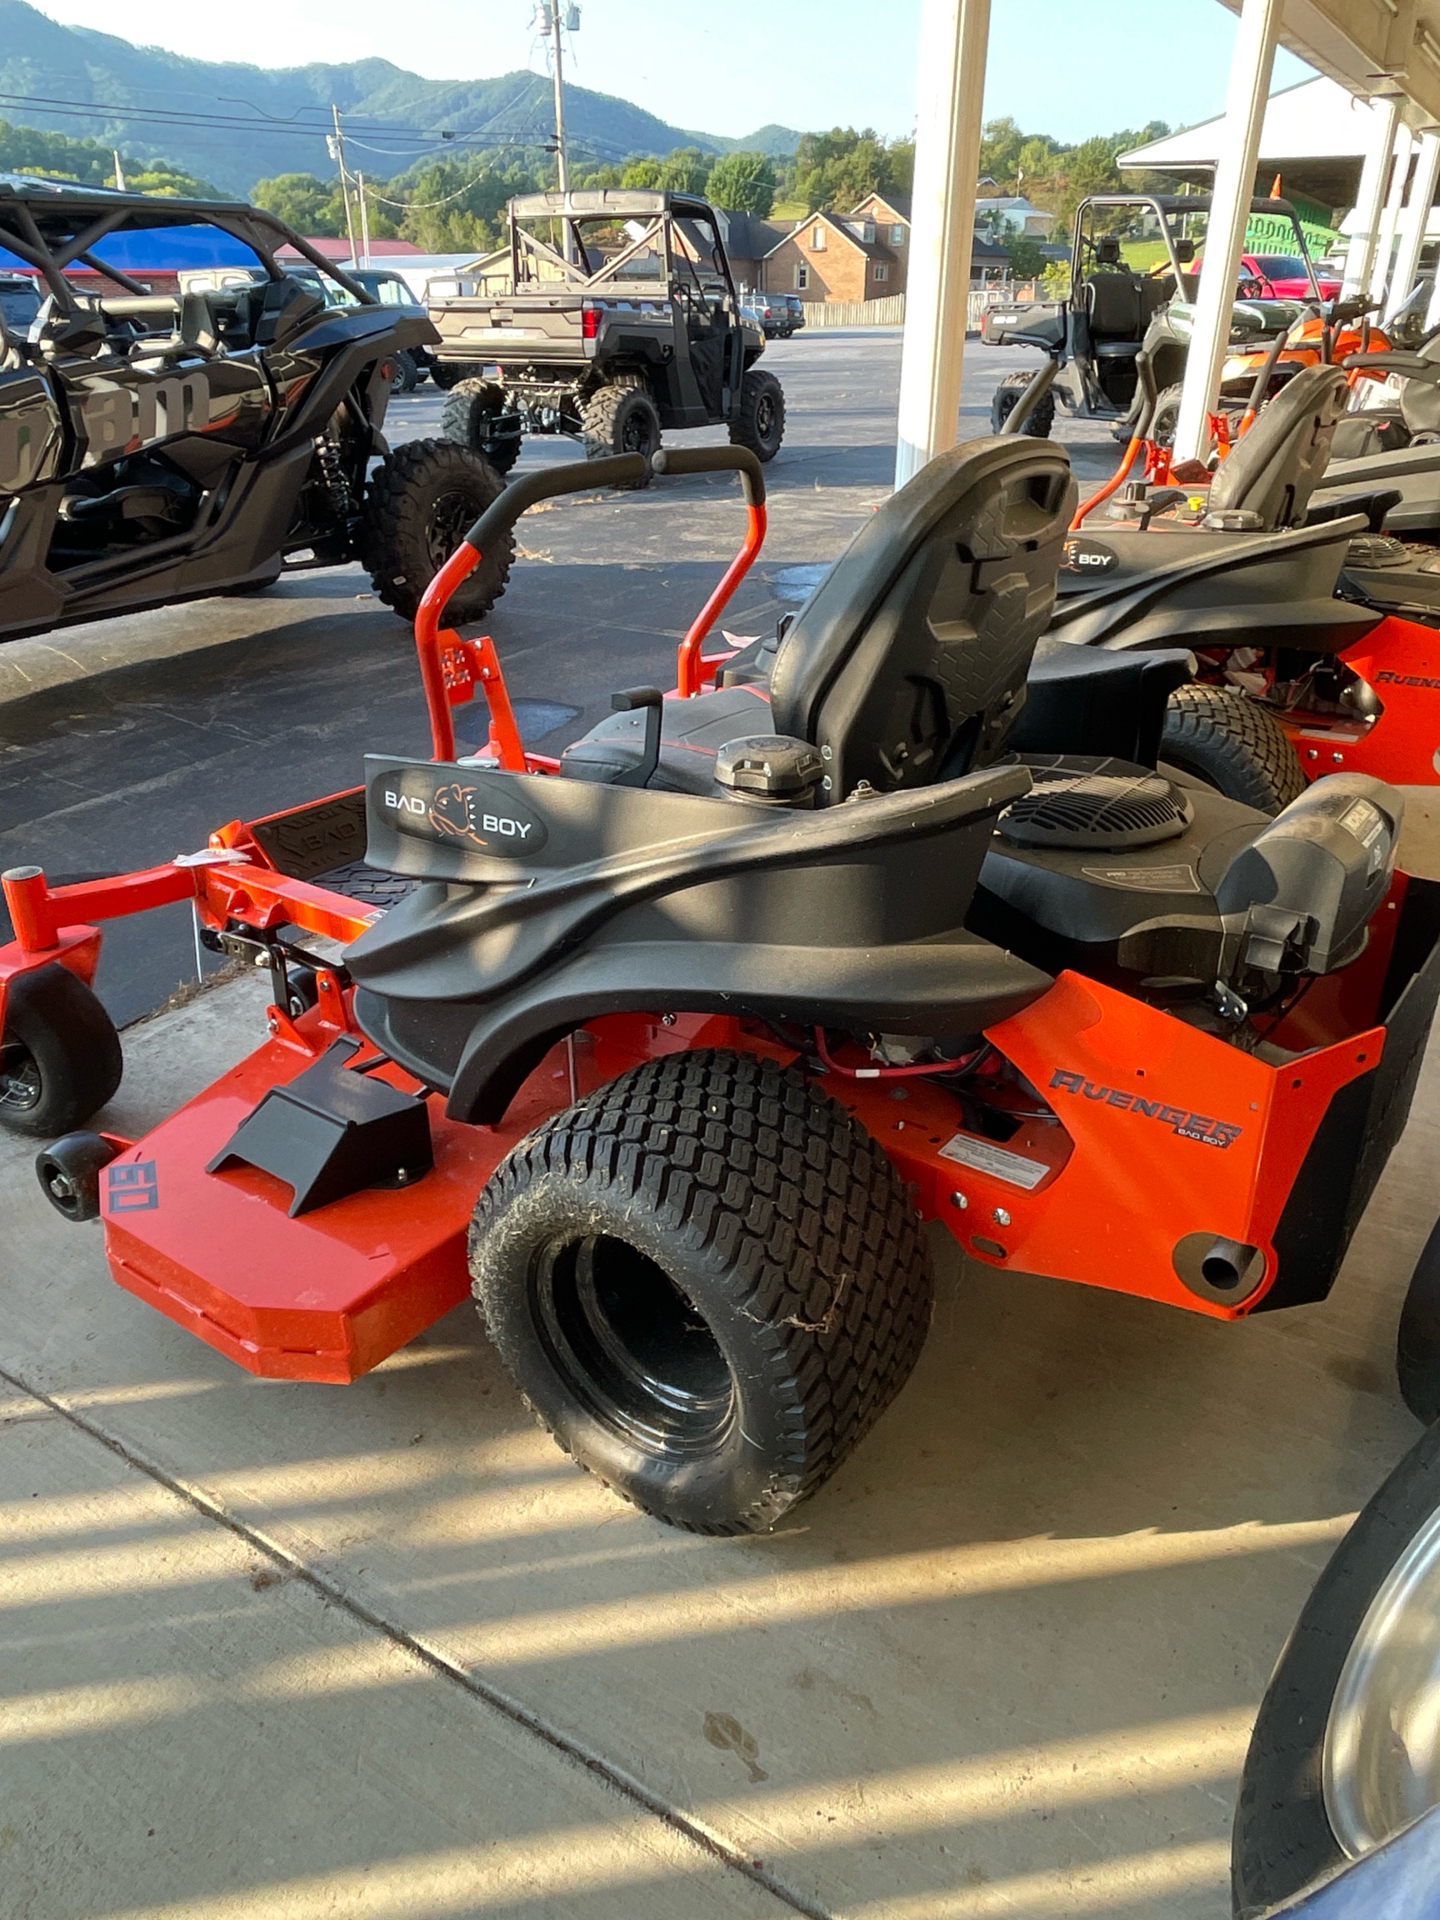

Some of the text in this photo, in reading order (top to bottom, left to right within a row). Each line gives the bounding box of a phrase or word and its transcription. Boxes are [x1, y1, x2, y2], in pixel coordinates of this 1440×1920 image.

[1078, 554, 1112, 566] BOY
[384, 790, 532, 839] BAD BOY
[300, 822, 359, 851] BAD
[1048, 1067, 1244, 1142] AVENGER
[1177, 1127, 1227, 1148] BAD BOY
[108, 1159, 159, 1214] 60
